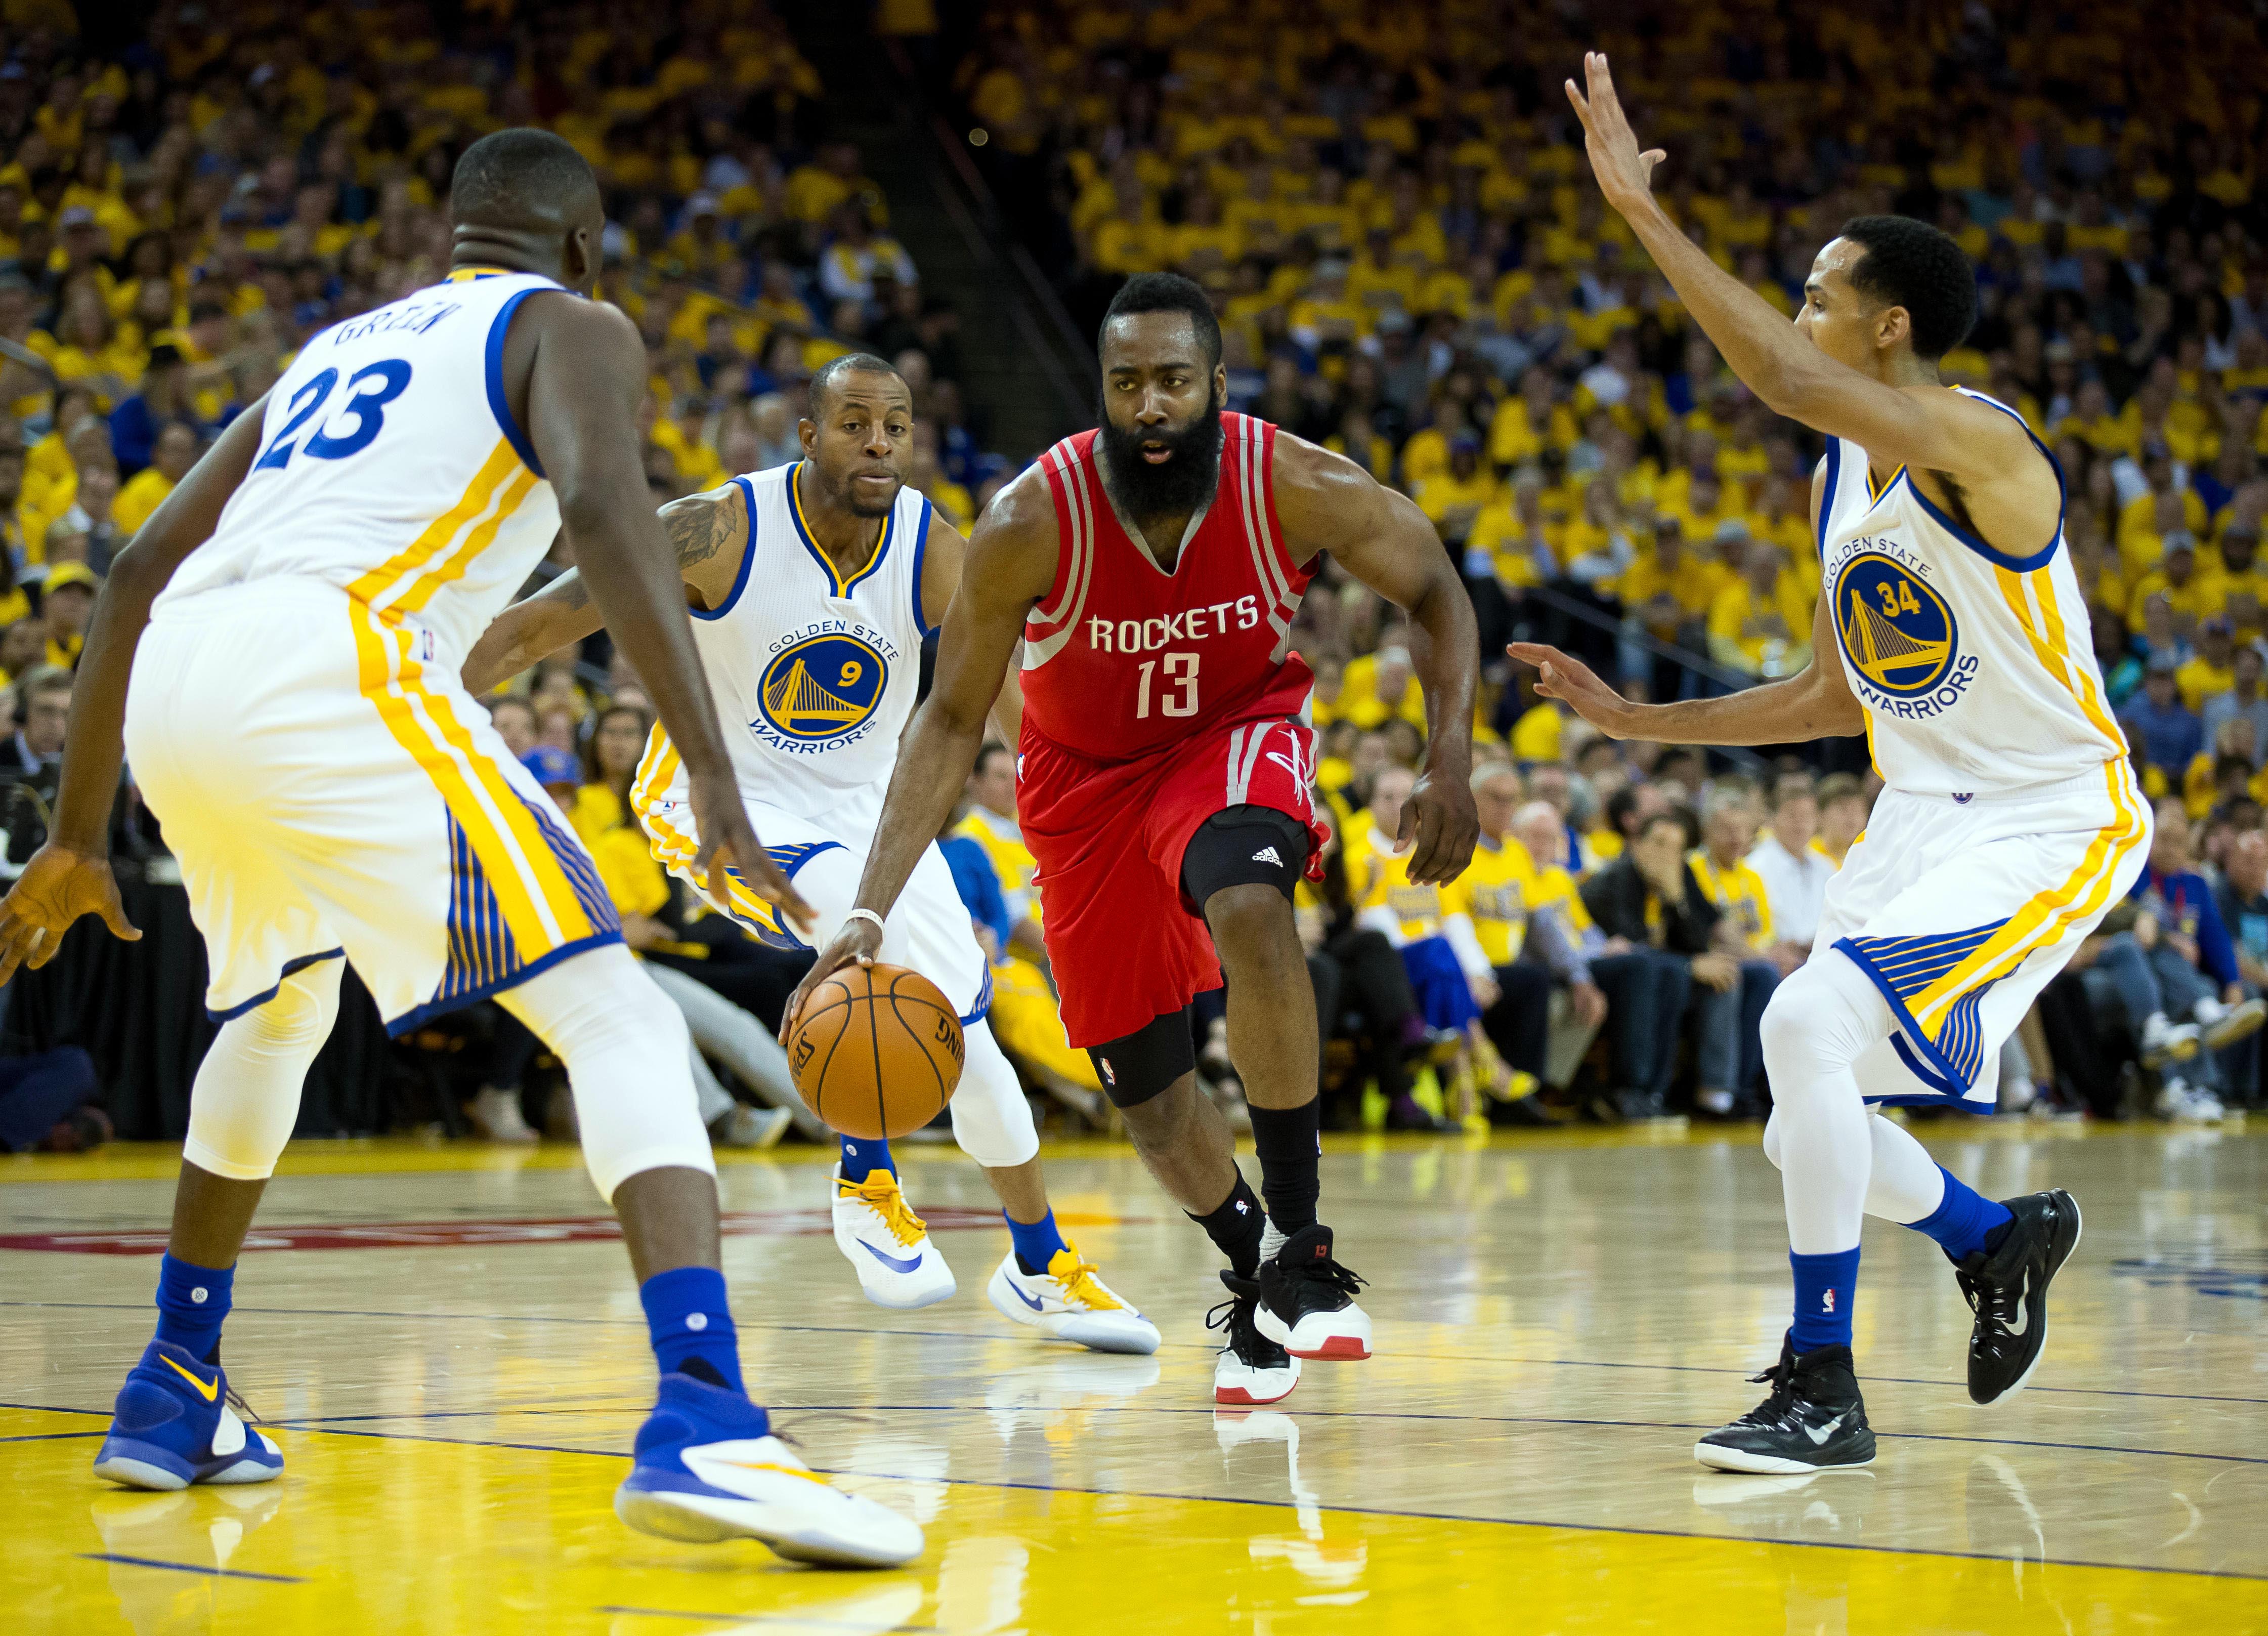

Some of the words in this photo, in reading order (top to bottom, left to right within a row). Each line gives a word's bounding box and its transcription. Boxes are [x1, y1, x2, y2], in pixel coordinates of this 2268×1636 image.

[334, 302, 461, 346] GREEN
[253, 358, 412, 474] 23
[1825, 536, 1872, 590] GOLDEN
[1878, 538, 1933, 578] STATE
[1875, 579, 1921, 617] 34
[769, 620, 846, 653] GOLDEN
[852, 624, 899, 661] STATE
[1085, 594, 1259, 653] ROCKETS
[837, 660, 863, 687] 9
[1137, 652, 1200, 719] 13
[1855, 654, 1979, 720] WARRIORS
[748, 718, 877, 754] WARRIORS
[1252, 854, 1283, 868] adidas
